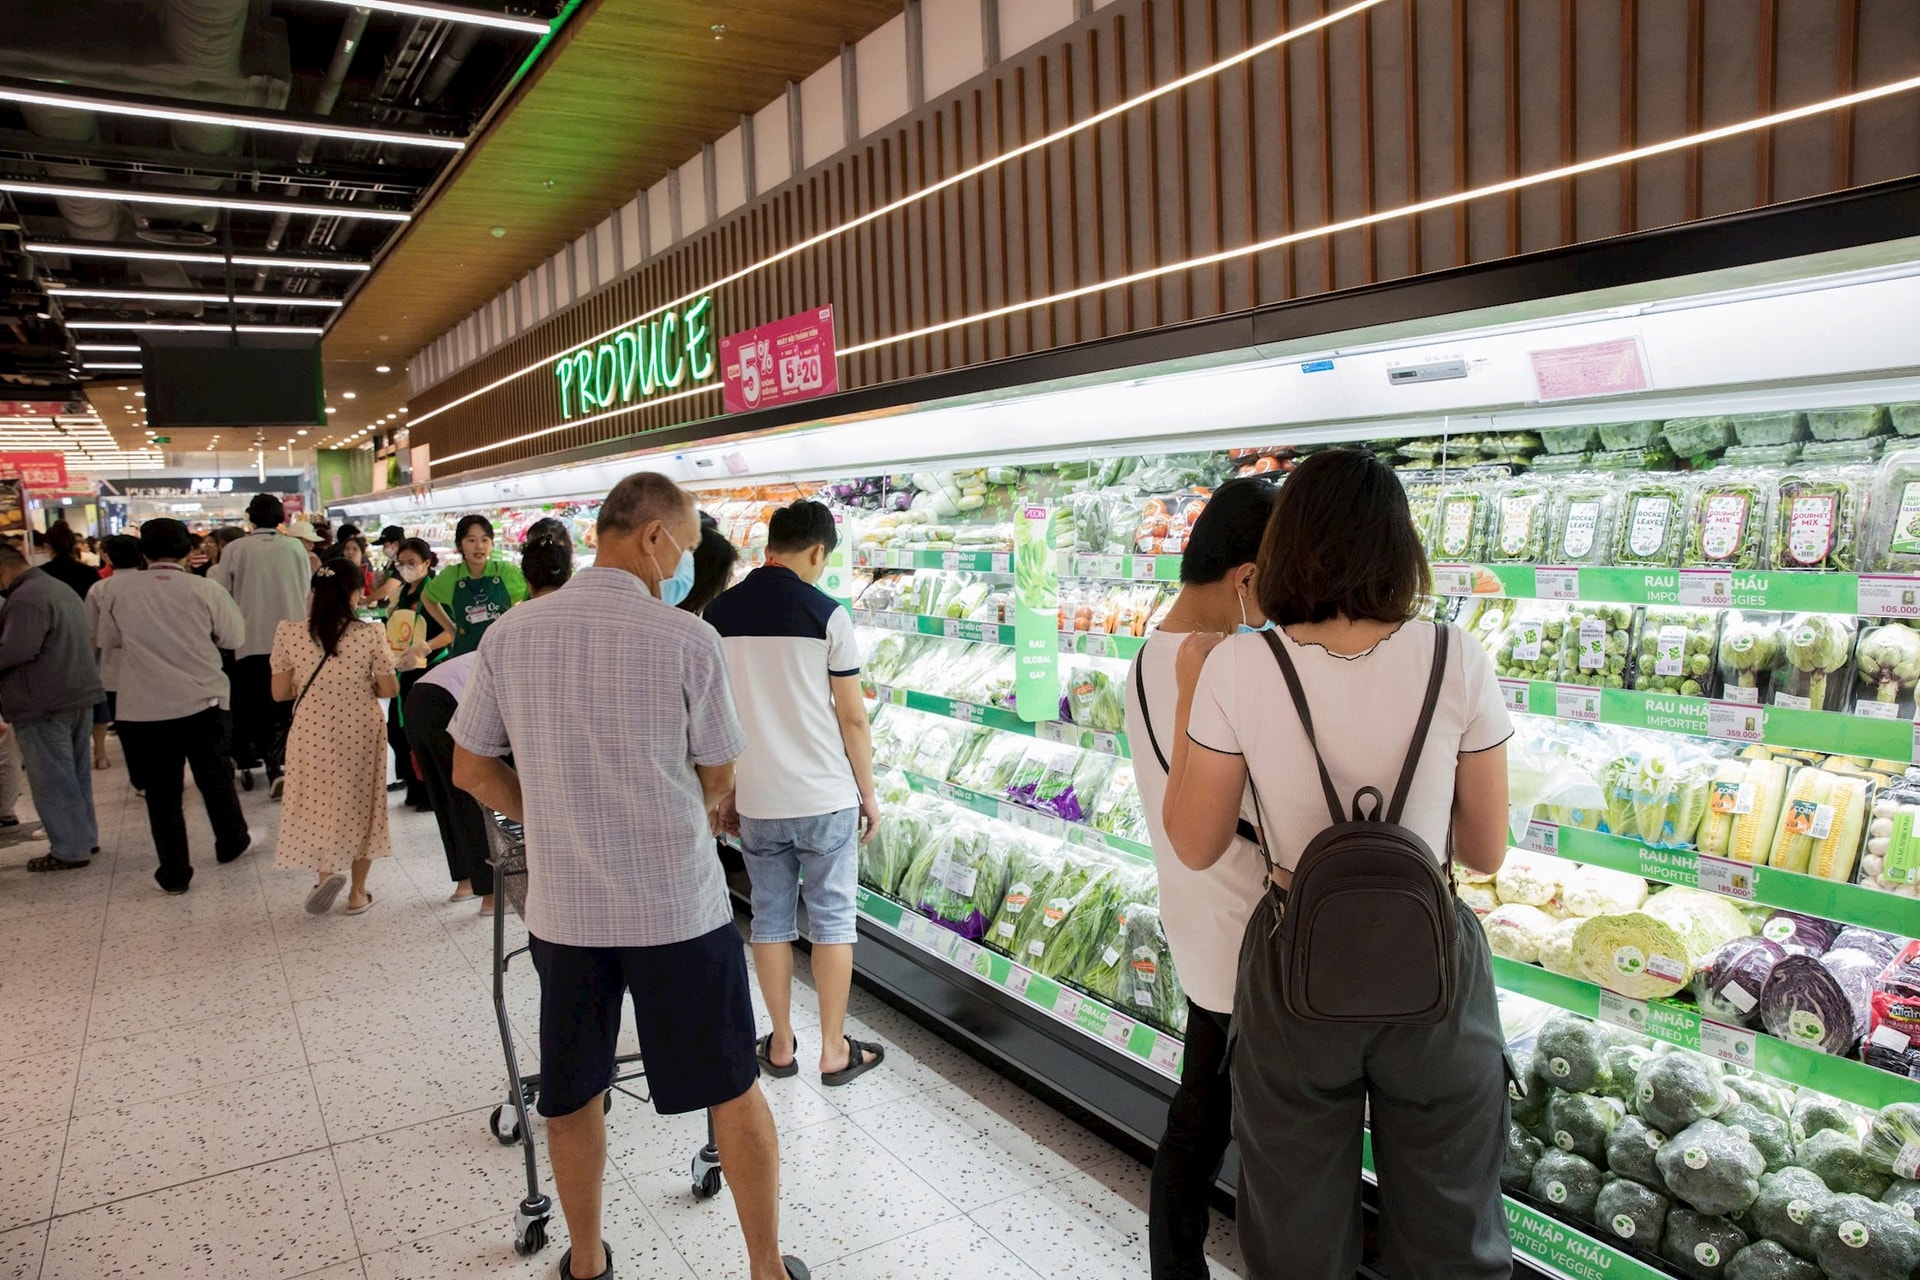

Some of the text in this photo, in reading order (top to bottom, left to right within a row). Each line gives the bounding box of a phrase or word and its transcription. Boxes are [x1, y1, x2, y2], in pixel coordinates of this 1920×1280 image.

[556, 296, 715, 419] PRODUCE
[802, 358, 819, 384] 20
[190, 478, 224, 492] MLB
[1637, 510, 1666, 518] ROCKET
[1636, 518, 1665, 527] LEAVES
[1645, 575, 1675, 587] RAU
[1647, 591, 1680, 602] IMPO
[1029, 640, 1046, 649] RAU
[1022, 656, 1053, 665] GLOBAL
[1029, 671, 1046, 680] GAP
[1645, 699, 1675, 713] RAU
[1647, 714, 1708, 732] IMPORTED
[1639, 848, 1668, 864] RAU
[1641, 863, 1699, 884] IMPORTED
[1654, 1009, 1695, 1031] NHẬP
[1503, 1205, 1520, 1224] U
[1521, 1217, 1565, 1245] NHẬP
[1551, 1247, 1604, 1280] VEGGIES
